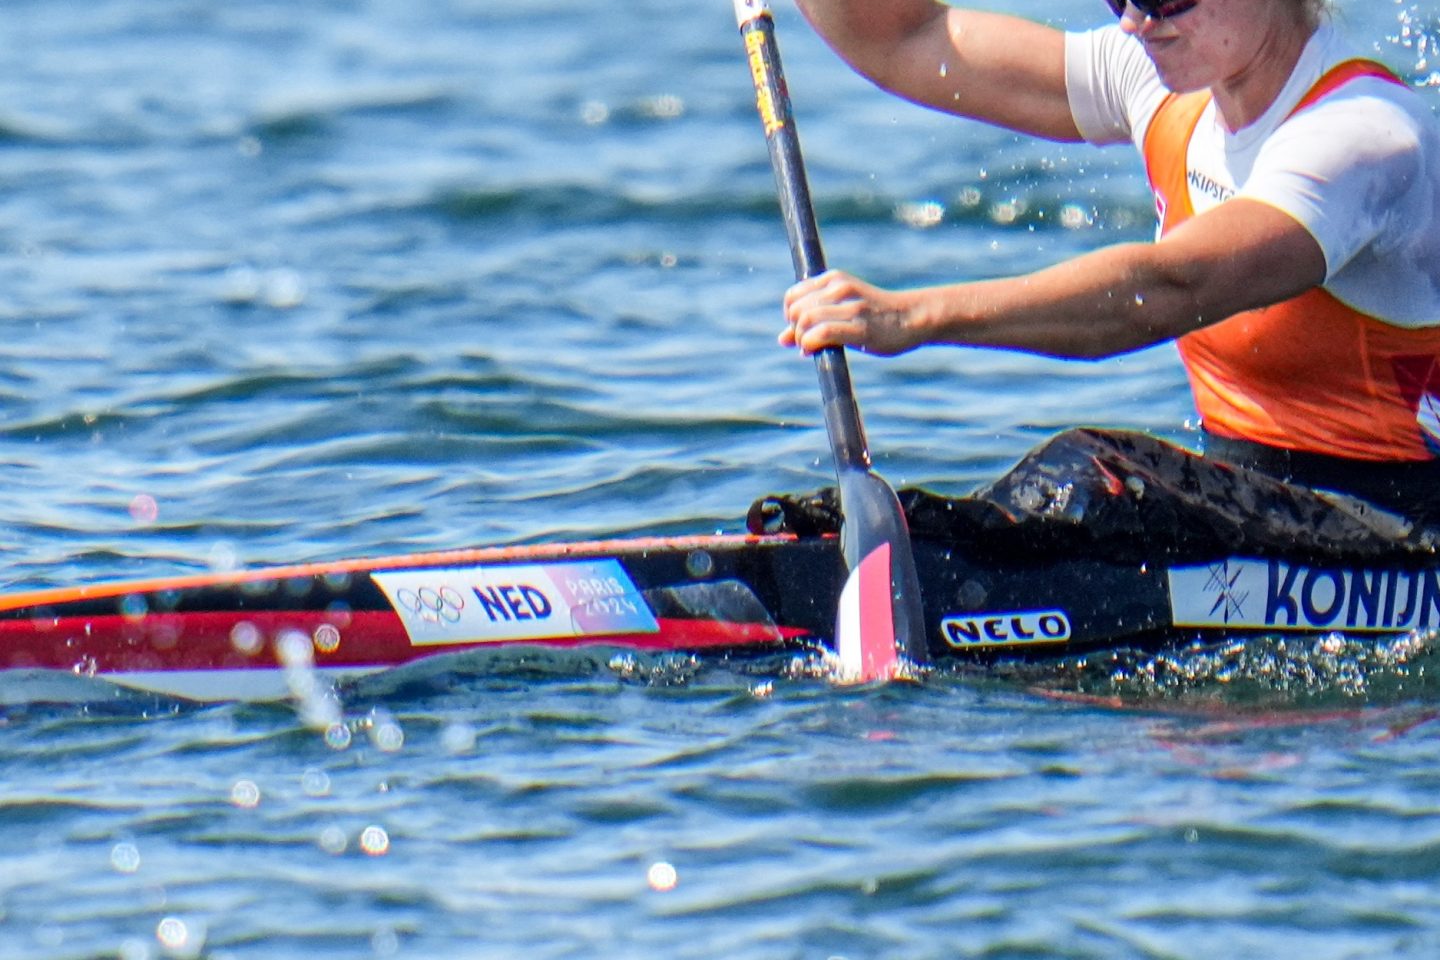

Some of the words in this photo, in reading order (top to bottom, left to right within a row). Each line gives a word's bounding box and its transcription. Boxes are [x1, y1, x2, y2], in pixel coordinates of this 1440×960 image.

[565, 577, 625, 596] PARIS
[471, 584, 553, 622] NED
[946, 614, 1067, 643] NELO
